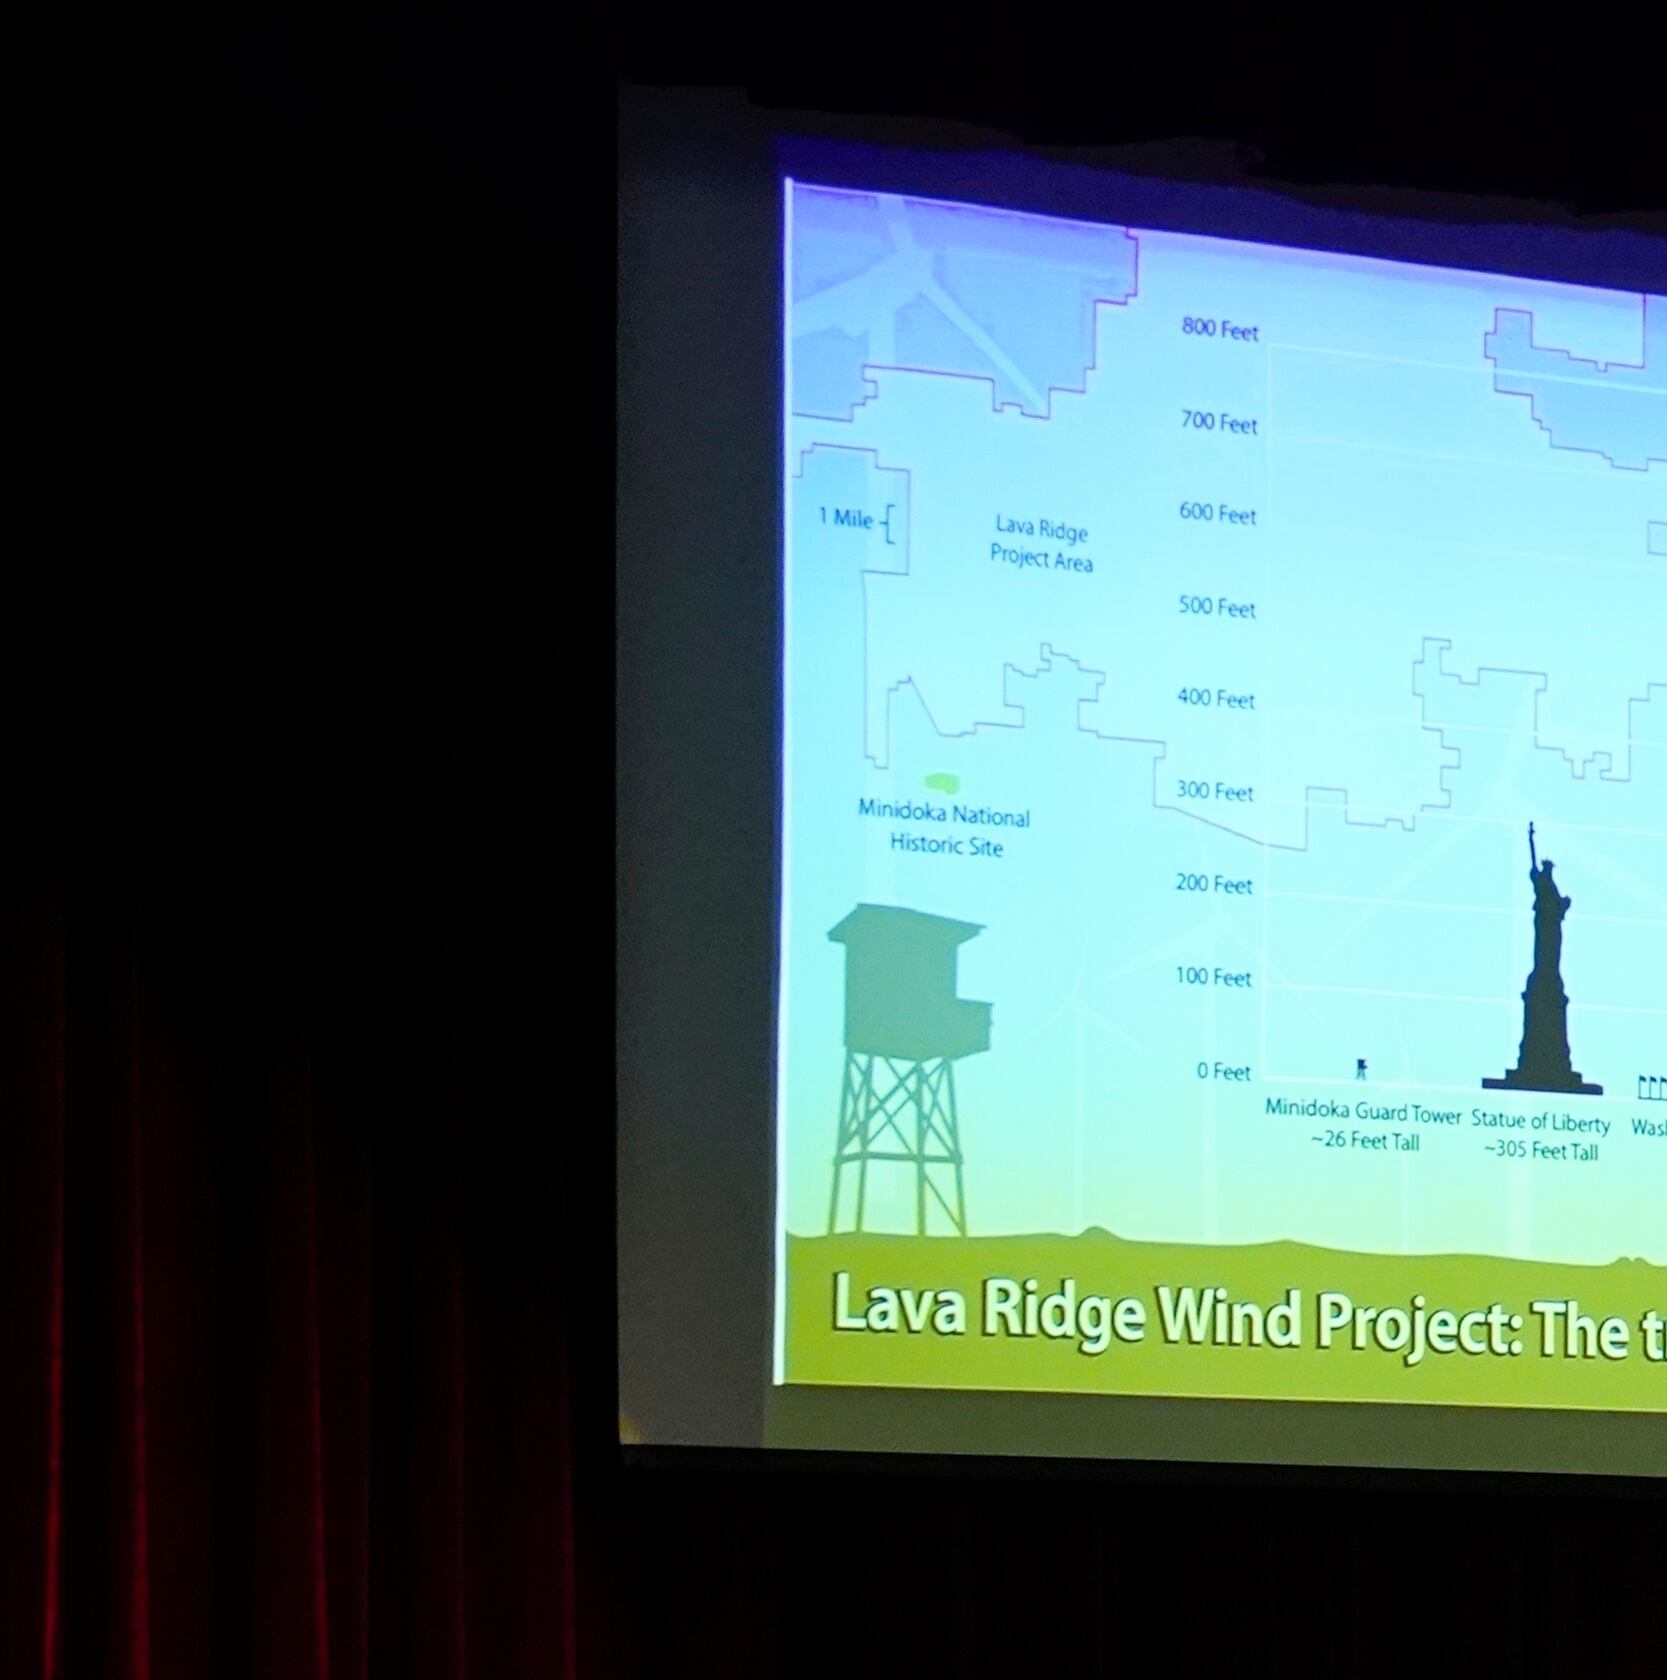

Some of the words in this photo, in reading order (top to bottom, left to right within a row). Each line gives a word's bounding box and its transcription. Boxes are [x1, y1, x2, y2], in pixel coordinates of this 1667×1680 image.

[1181, 316, 1217, 337] 800
[1221, 319, 1259, 342] Feet
[1182, 409, 1216, 431] 700
[1220, 413, 1258, 436] Feet
[819, 506, 827, 524] 1
[833, 507, 874, 530] Mile
[1179, 501, 1214, 521] 600
[1218, 503, 1257, 526] Feet
[996, 513, 1035, 536] Lava
[1039, 518, 1089, 547] Ridge
[990, 542, 1050, 569] Project
[1054, 551, 1094, 574] Area
[1179, 594, 1214, 615] 500
[1218, 597, 1256, 619] Feet
[1177, 687, 1212, 707] 400
[1216, 688, 1255, 710] Feet
[1177, 779, 1210, 800] 300
[1215, 781, 1254, 802] Feet
[858, 797, 947, 822] Minidoka
[952, 804, 1030, 828] National
[890, 832, 964, 856] Historic
[969, 836, 1004, 858] Site
[1175, 872, 1209, 892] 200
[1214, 874, 1253, 895] Feet
[1176, 966, 1209, 985] 100
[1214, 967, 1252, 988] Feet
[1196, 1061, 1209, 1080] 0
[1214, 1061, 1251, 1082] Feet
[1265, 1097, 1350, 1119] Minidoka
[1355, 1101, 1408, 1122] Guard
[1411, 1104, 1463, 1126] Tower
[1471, 1108, 1526, 1129] Statue
[1530, 1111, 1548, 1130] of
[1552, 1113, 1611, 1138] Liberty
[1351, 1130, 1388, 1150] Feet
[1391, 1132, 1420, 1151] Tall
[1532, 1140, 1567, 1161] Feet
[1570, 1142, 1599, 1161] Tall
[837, 1273, 965, 1333] Lava
[986, 1278, 1146, 1353] Ridge
[1158, 1286, 1301, 1346] Wind
[1320, 1292, 1523, 1364] Project:
[1533, 1300, 1630, 1358] The
